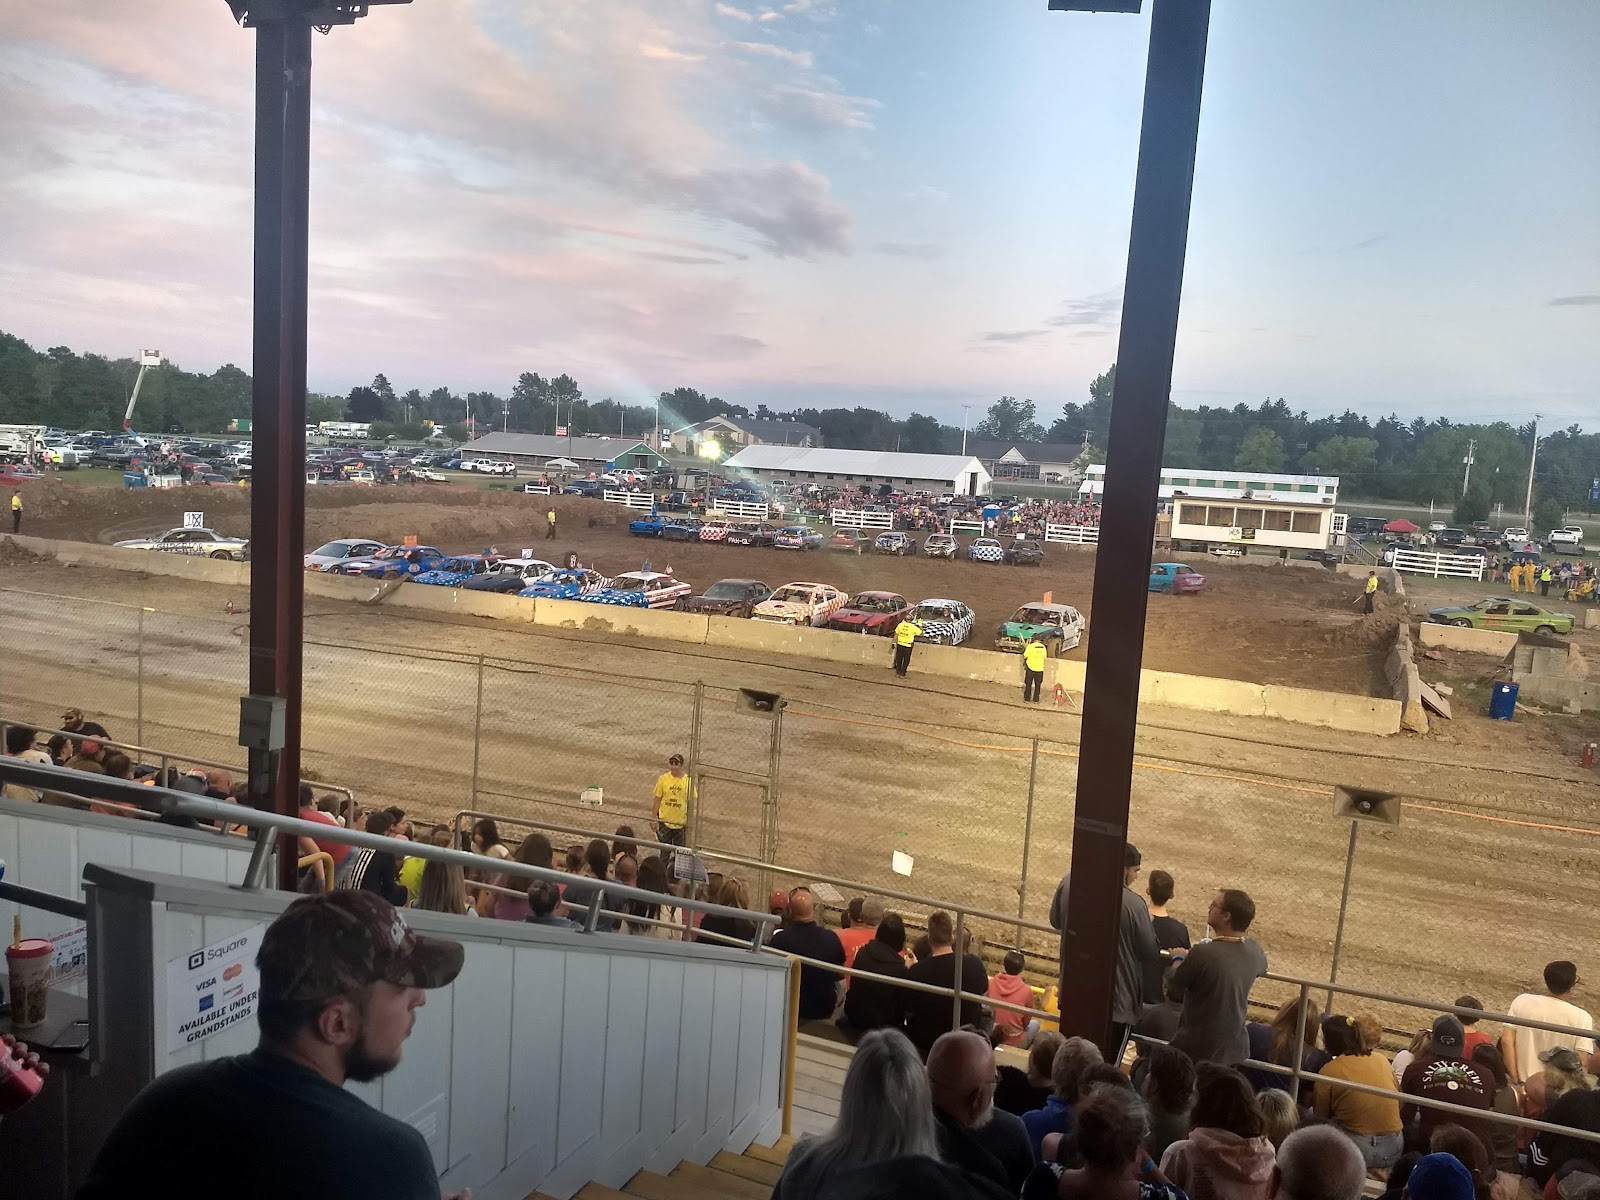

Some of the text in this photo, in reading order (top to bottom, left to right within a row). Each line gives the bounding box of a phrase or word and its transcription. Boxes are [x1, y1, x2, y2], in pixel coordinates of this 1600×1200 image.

[207, 937, 248, 961] Square
[196, 976, 217, 992] VISA
[178, 990, 258, 1034] AVAILABLE UNDER
[187, 1005, 252, 1043] GRANDSTANDS
[1422, 1060, 1483, 1086] SALTY CREW
